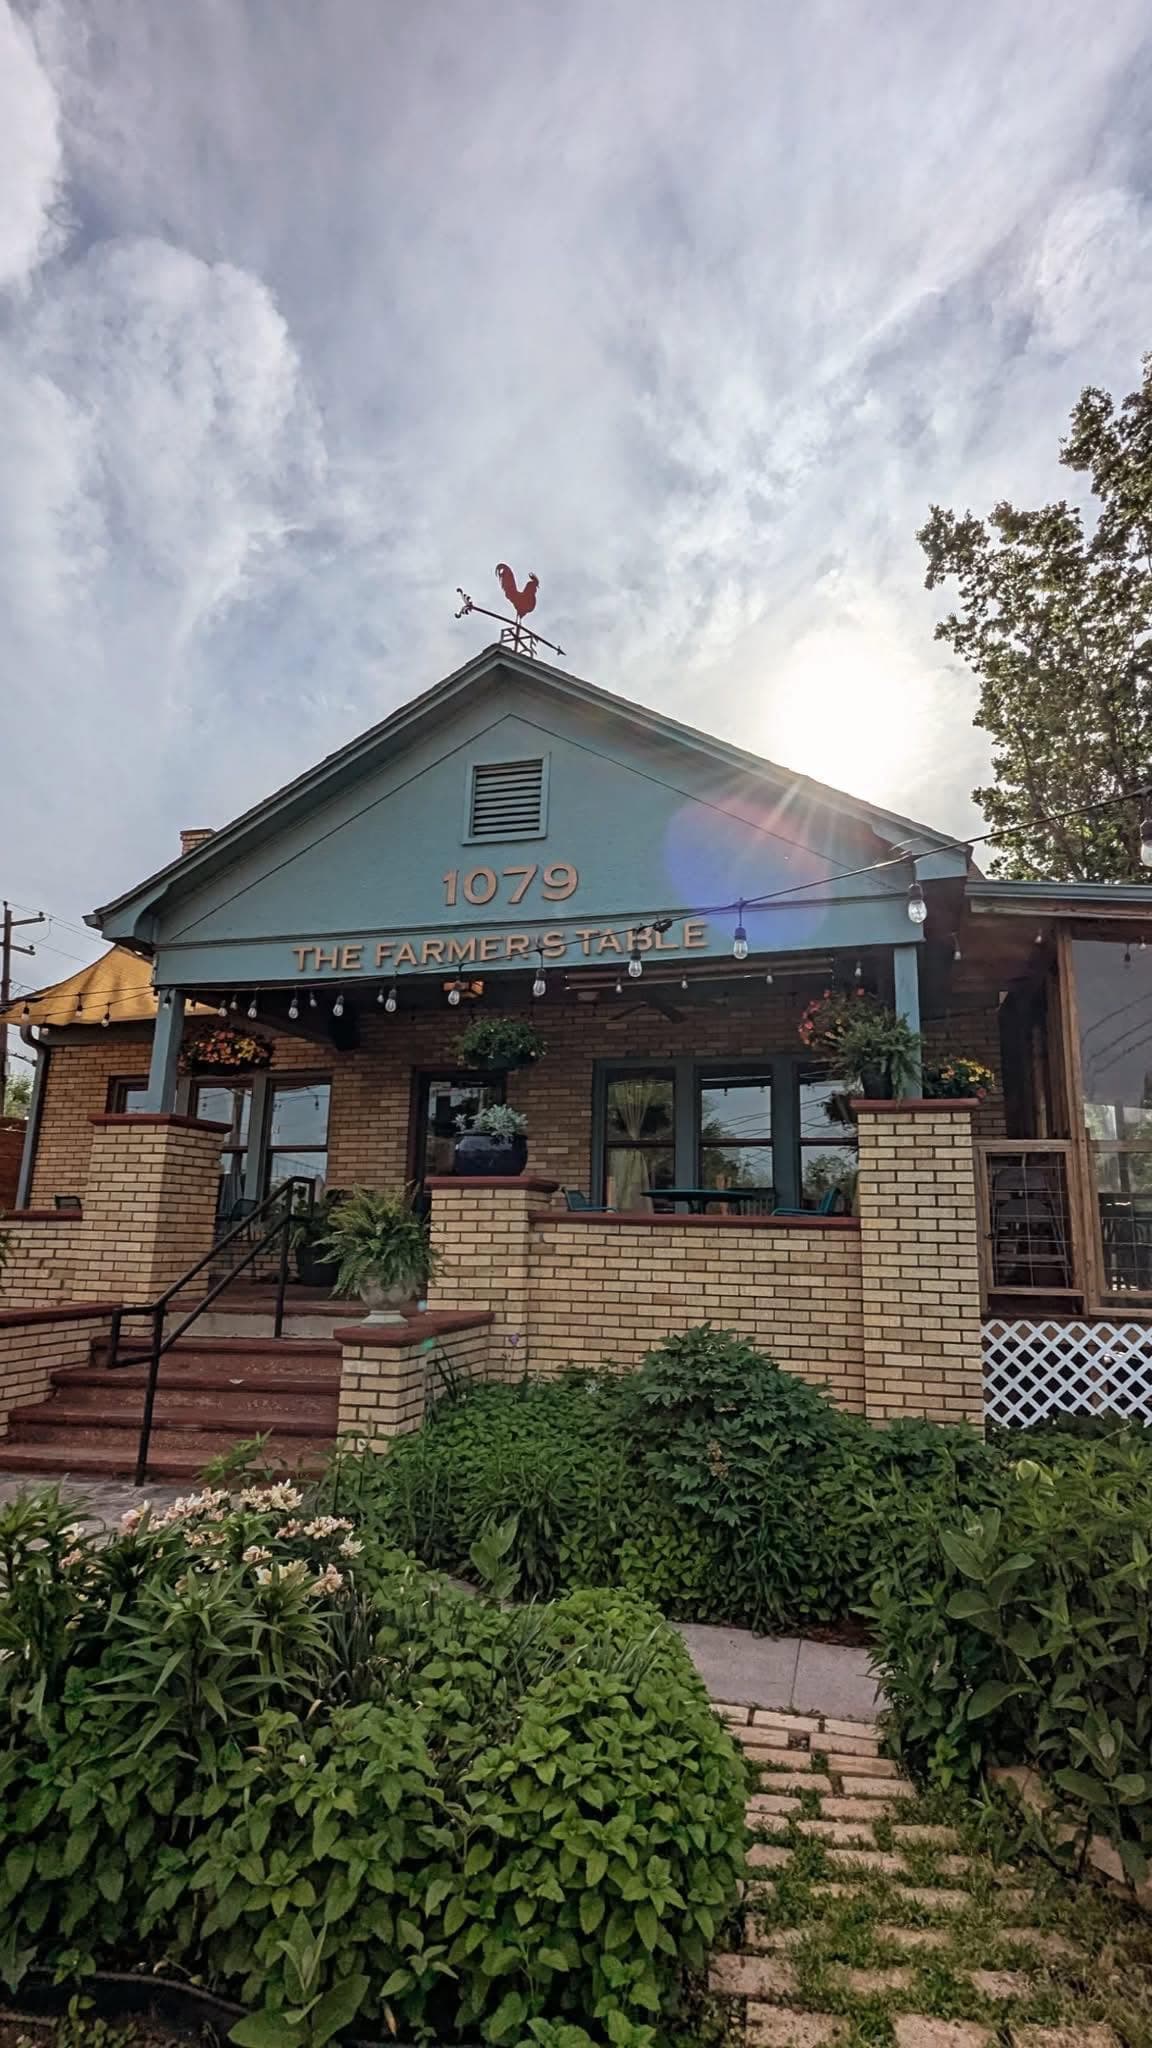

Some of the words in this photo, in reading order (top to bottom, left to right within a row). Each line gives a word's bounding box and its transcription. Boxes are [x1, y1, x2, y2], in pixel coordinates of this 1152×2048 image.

[443, 863, 579, 906] 1079
[293, 944, 364, 972] THE
[575, 921, 709, 956] TABLE
